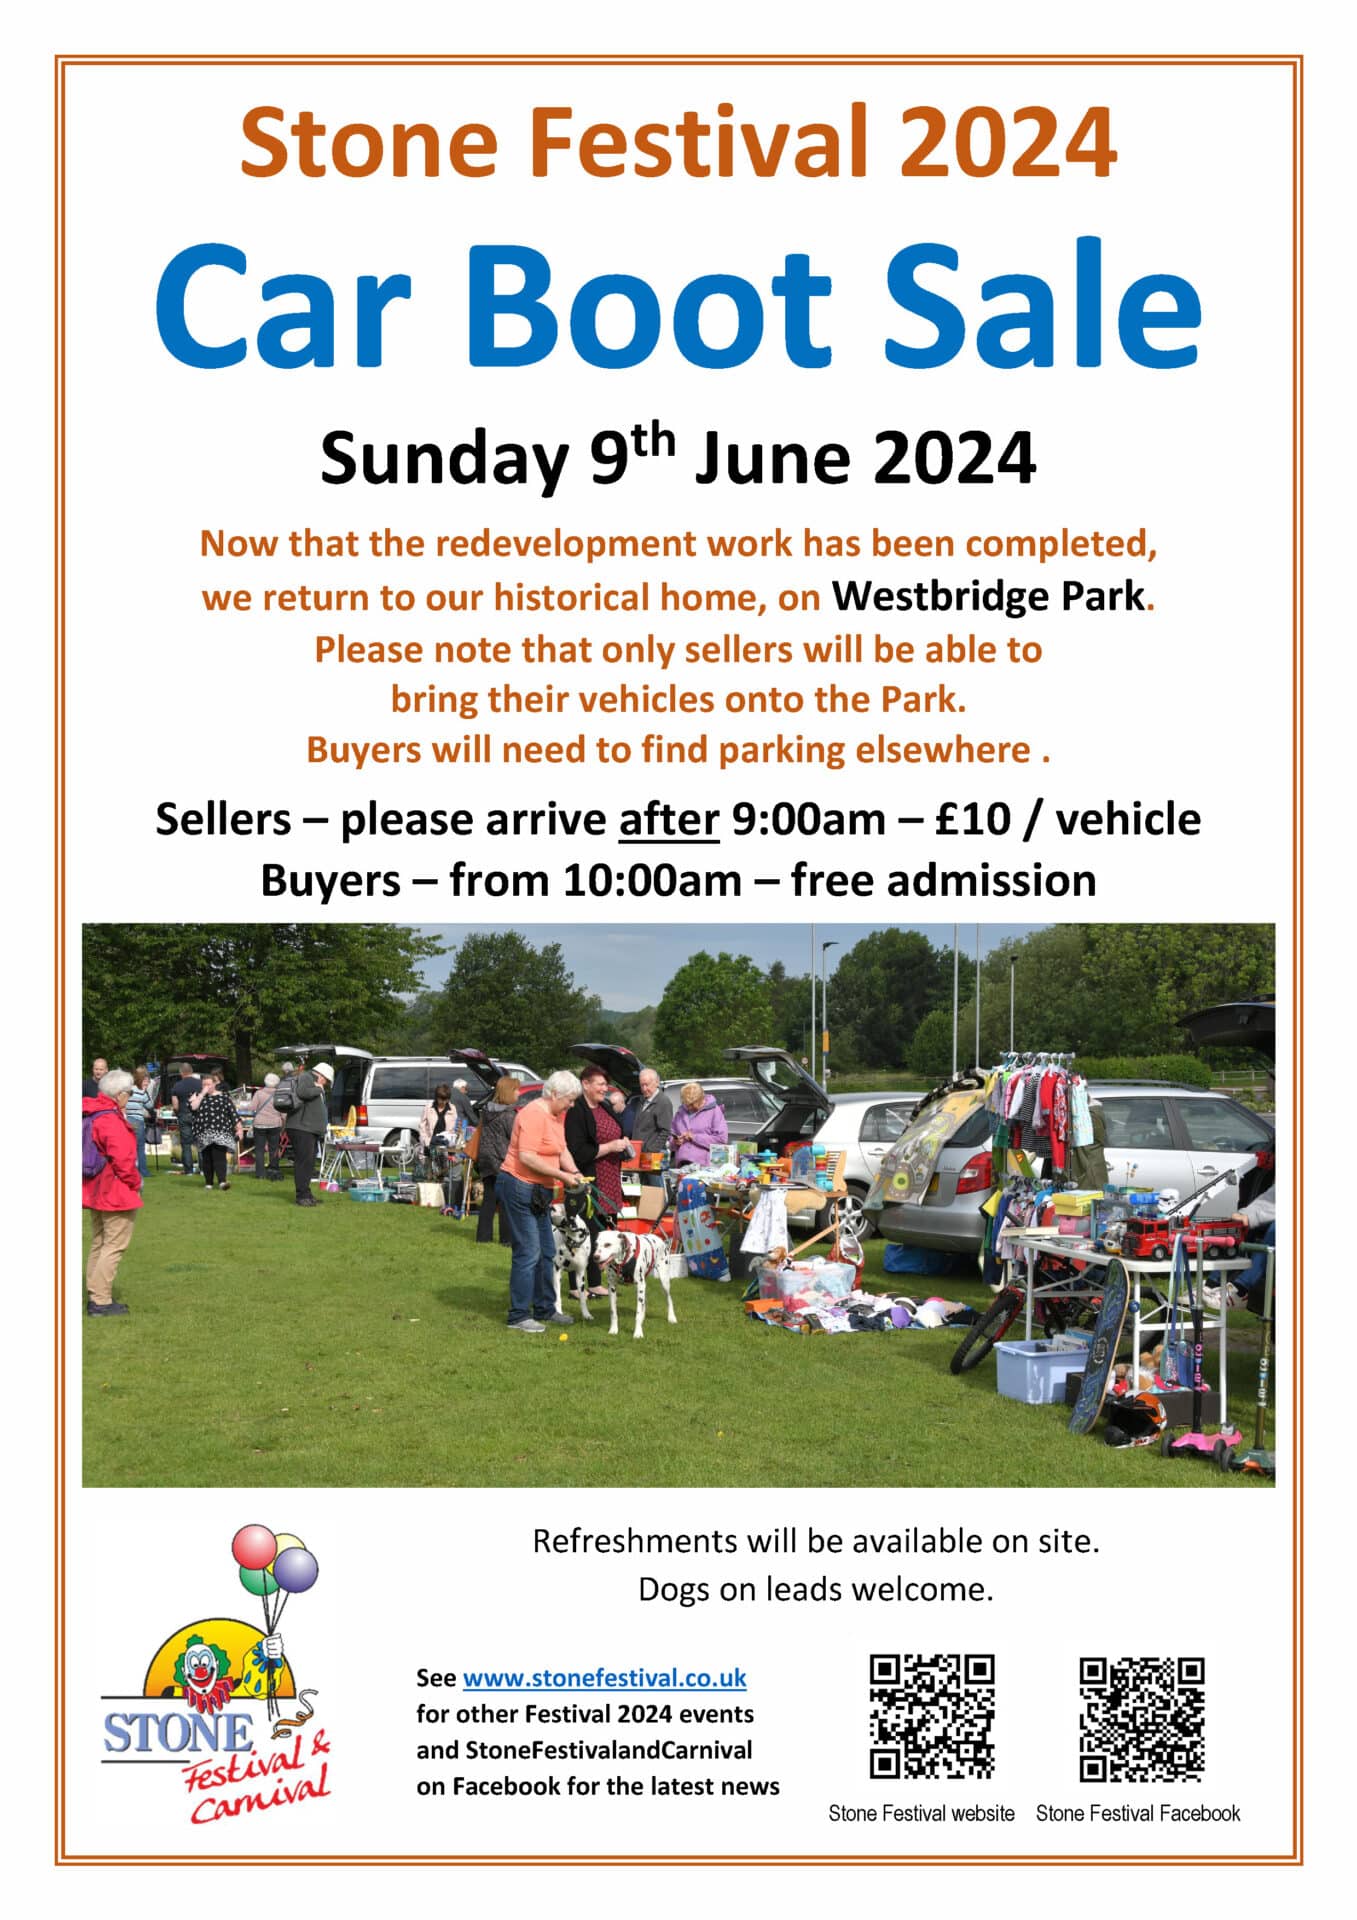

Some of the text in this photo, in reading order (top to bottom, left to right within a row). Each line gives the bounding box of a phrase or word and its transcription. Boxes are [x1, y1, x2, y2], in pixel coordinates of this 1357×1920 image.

[240, 100, 1119, 179] Stone Festival 2024
[155, 234, 1202, 370] Car Boot Sale
[321, 418, 1038, 499] Sunday 9th June 2024
[200, 527, 1157, 564] Now that the redevelopment work has been completed,
[201, 578, 1155, 620] we return to our historical home, on Westbridge Park.
[315, 633, 1043, 671] Please note that only sellers will be able to
[392, 683, 966, 720] bring their vehicles onto the Park.
[307, 735, 422, 771] Buyers
[431, 733, 491, 764] will
[503, 733, 586, 764] need
[595, 737, 632, 764] to
[641, 733, 708, 764] find
[719, 733, 846, 771] parking
[856, 733, 1031, 764] elsewhere
[156, 799, 292, 836] Sellers
[342, 799, 474, 844] please
[486, 800, 607, 836] arrive
[617, 799, 721, 839] after
[732, 801, 885, 836] 9:00am
[935, 801, 1011, 836] £10
[1055, 799, 1202, 836] vehicle
[262, 863, 401, 906] Buyers
[449, 860, 549, 897] from
[564, 862, 742, 897] 10:00am
[790, 860, 875, 897] free
[887, 861, 1096, 897] admission
[534, 1526, 1099, 1554] Refreshments will be available on site.
[639, 1574, 993, 1608] Dogs on leads welcome.
[416, 1666, 748, 1691] See www.stonefestival.co.uk
[104, 1712, 254, 1753] STONE
[416, 1703, 755, 1724] for other Festival 2024 events
[181, 1728, 331, 1793] Festival &
[416, 1739, 753, 1760] and StoneFestivalandCarnival
[190, 1762, 331, 1825] Carnival
[416, 1775, 780, 1796] on Facebook for the latest news
[828, 1803, 1016, 1822] Stone Festival website
[1036, 1803, 1241, 1822] Stone Festival Facebook
